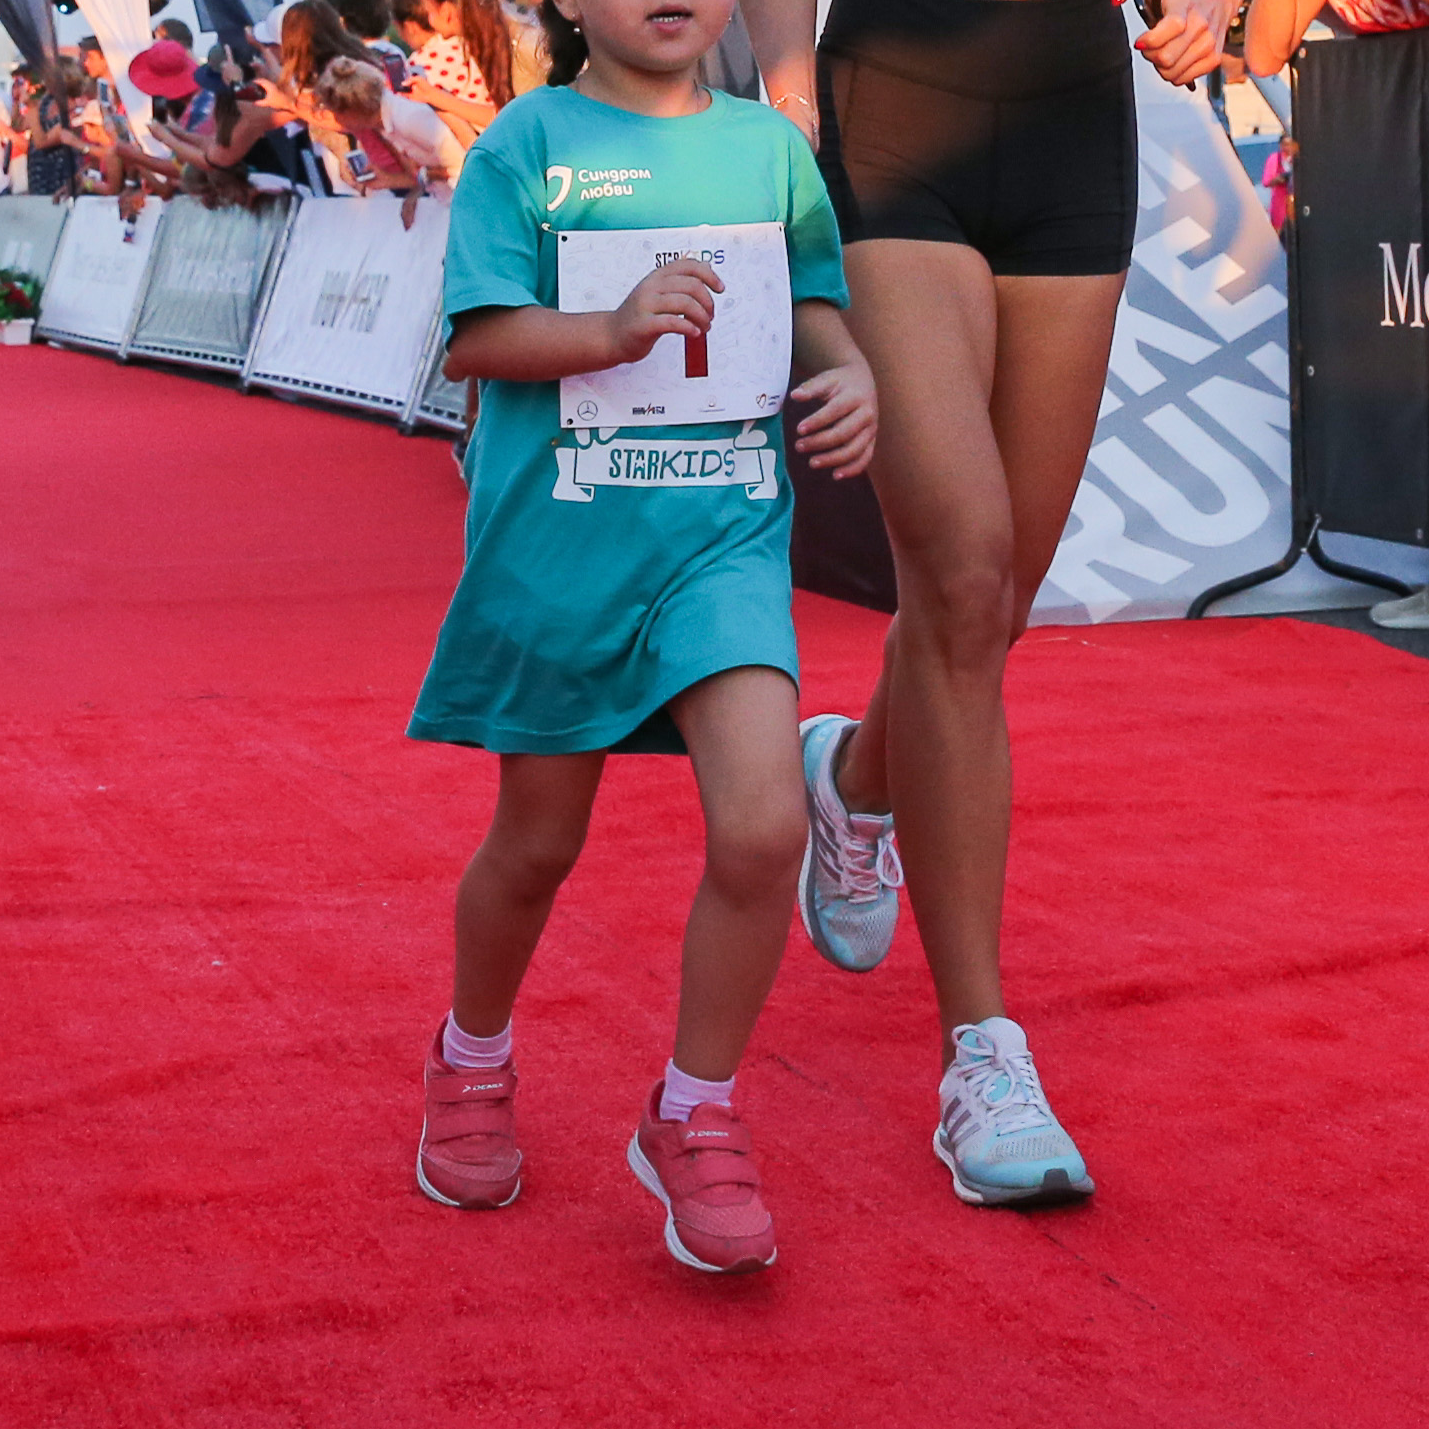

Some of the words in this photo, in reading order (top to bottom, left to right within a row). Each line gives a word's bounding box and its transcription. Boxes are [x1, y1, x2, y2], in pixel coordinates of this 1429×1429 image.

[577, 166, 652, 185] Синдром
[580, 181, 634, 200] любви
[609, 447, 736, 480] STARKIDS
